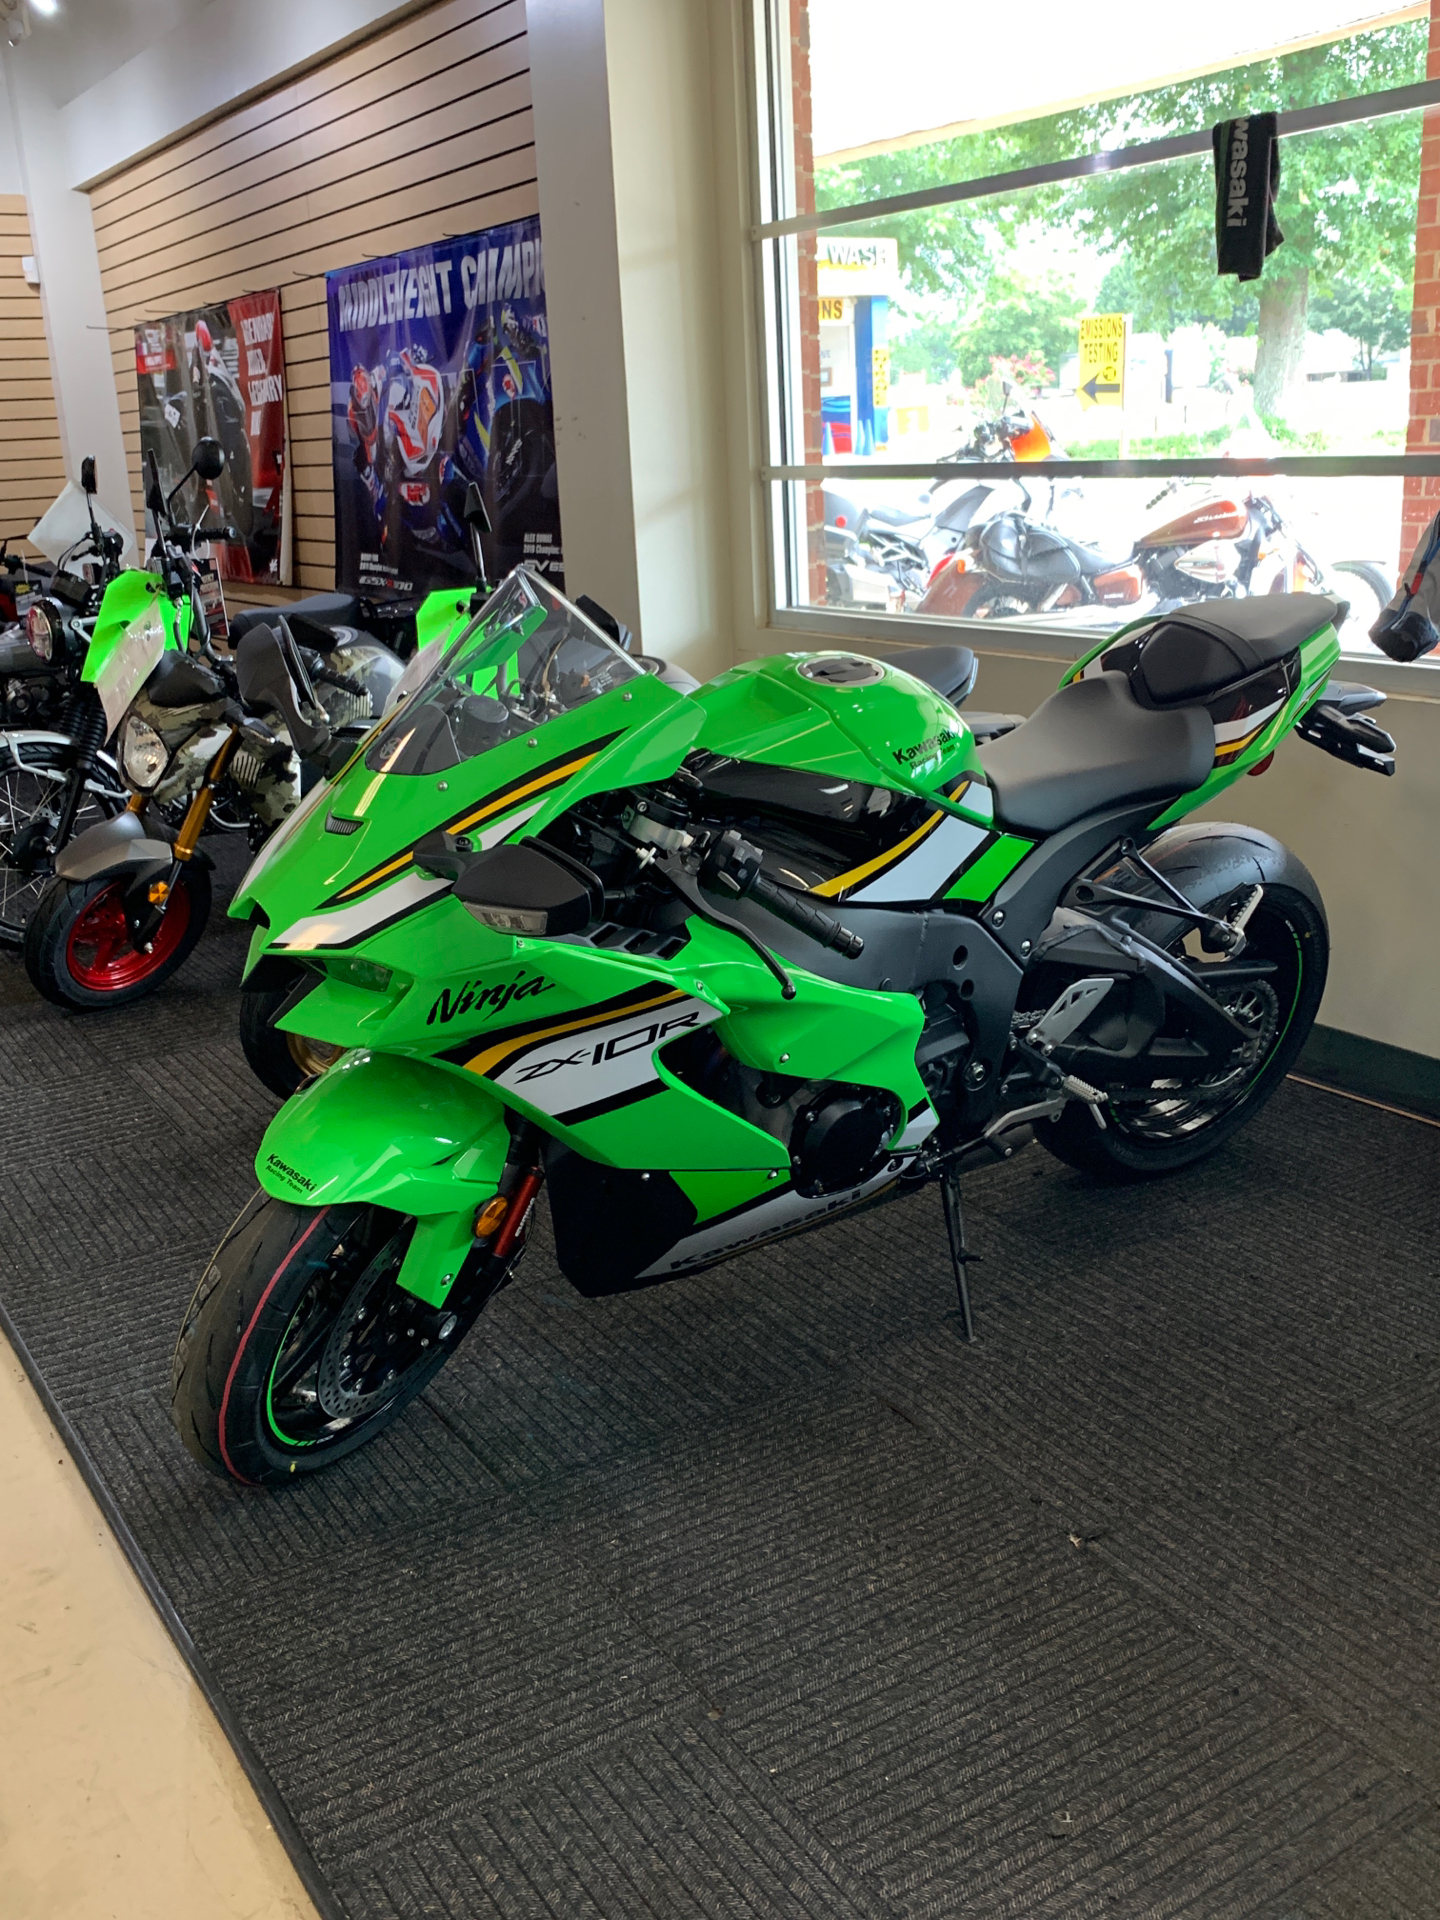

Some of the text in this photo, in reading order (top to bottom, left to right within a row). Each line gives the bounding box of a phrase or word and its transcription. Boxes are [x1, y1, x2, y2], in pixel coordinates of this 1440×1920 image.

[1080, 316, 1123, 341] EMISSIONS
[1083, 341, 1119, 364] TESTING
[892, 728, 957, 766] Kawasaki
[426, 970, 556, 1026] Ninja
[514, 1011, 702, 1085] ZX-10R
[265, 1165, 303, 1194] Racing Team
[266, 1153, 318, 1193] Kawasaki
[670, 1188, 862, 1270] Kawasaki
